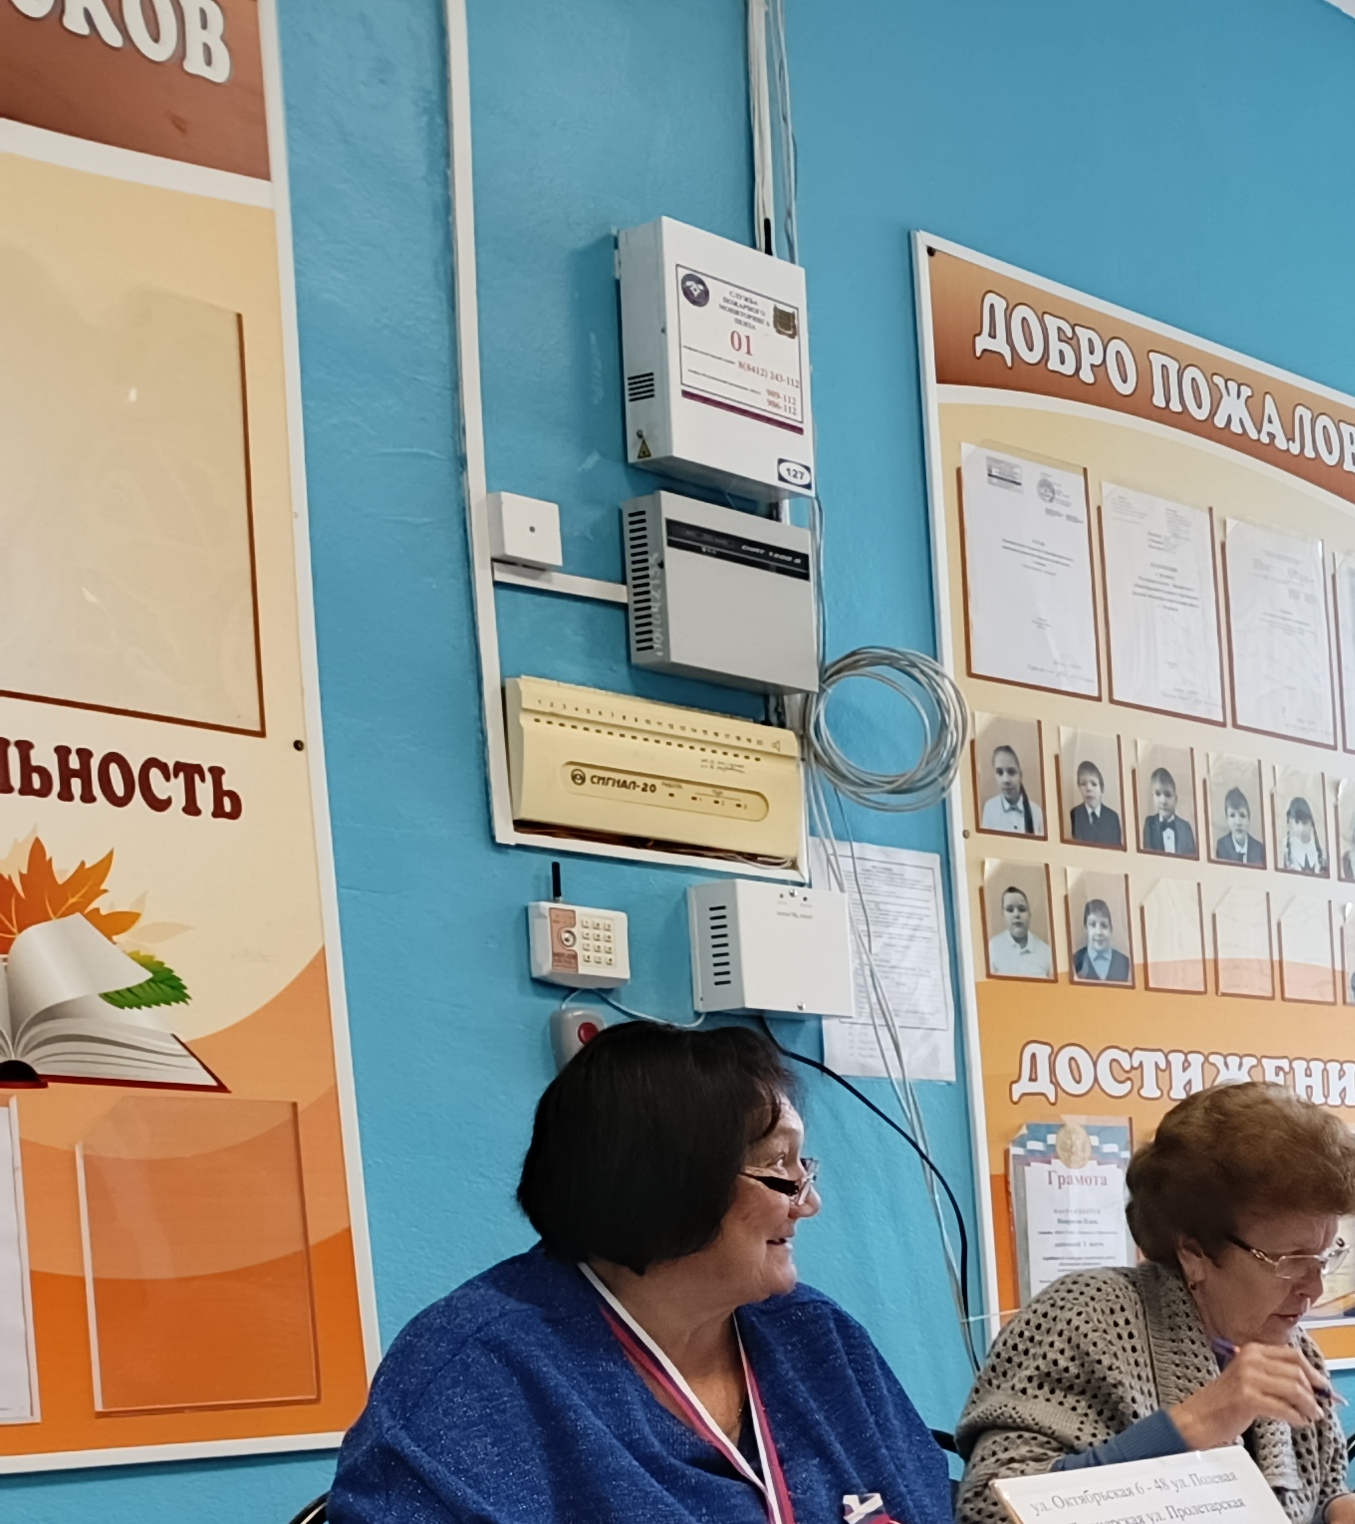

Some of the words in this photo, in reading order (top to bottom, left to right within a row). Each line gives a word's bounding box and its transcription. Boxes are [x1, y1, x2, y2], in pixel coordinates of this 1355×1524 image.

[8, 0, 232, 84] КОВ
[730, 330, 754, 356] 01
[974, 290, 1138, 396] ДОБРО
[786, 467, 806, 481] 127
[590, 775, 657, 793] СИГНАЛ-20
[1047, 1170, 1108, 1190] Грамота
[1030, 1500, 1052, 1517] ул.
[1051, 1485, 1135, 1509] Октябрьская
[1134, 1481, 1145, 1496] 6
[1154, 1477, 1171, 1493] 48
[1170, 1477, 1190, 1494] ул.
[1187, 1470, 1238, 1488] Полевая
[1165, 1498, 1247, 1521] Пролетарская
